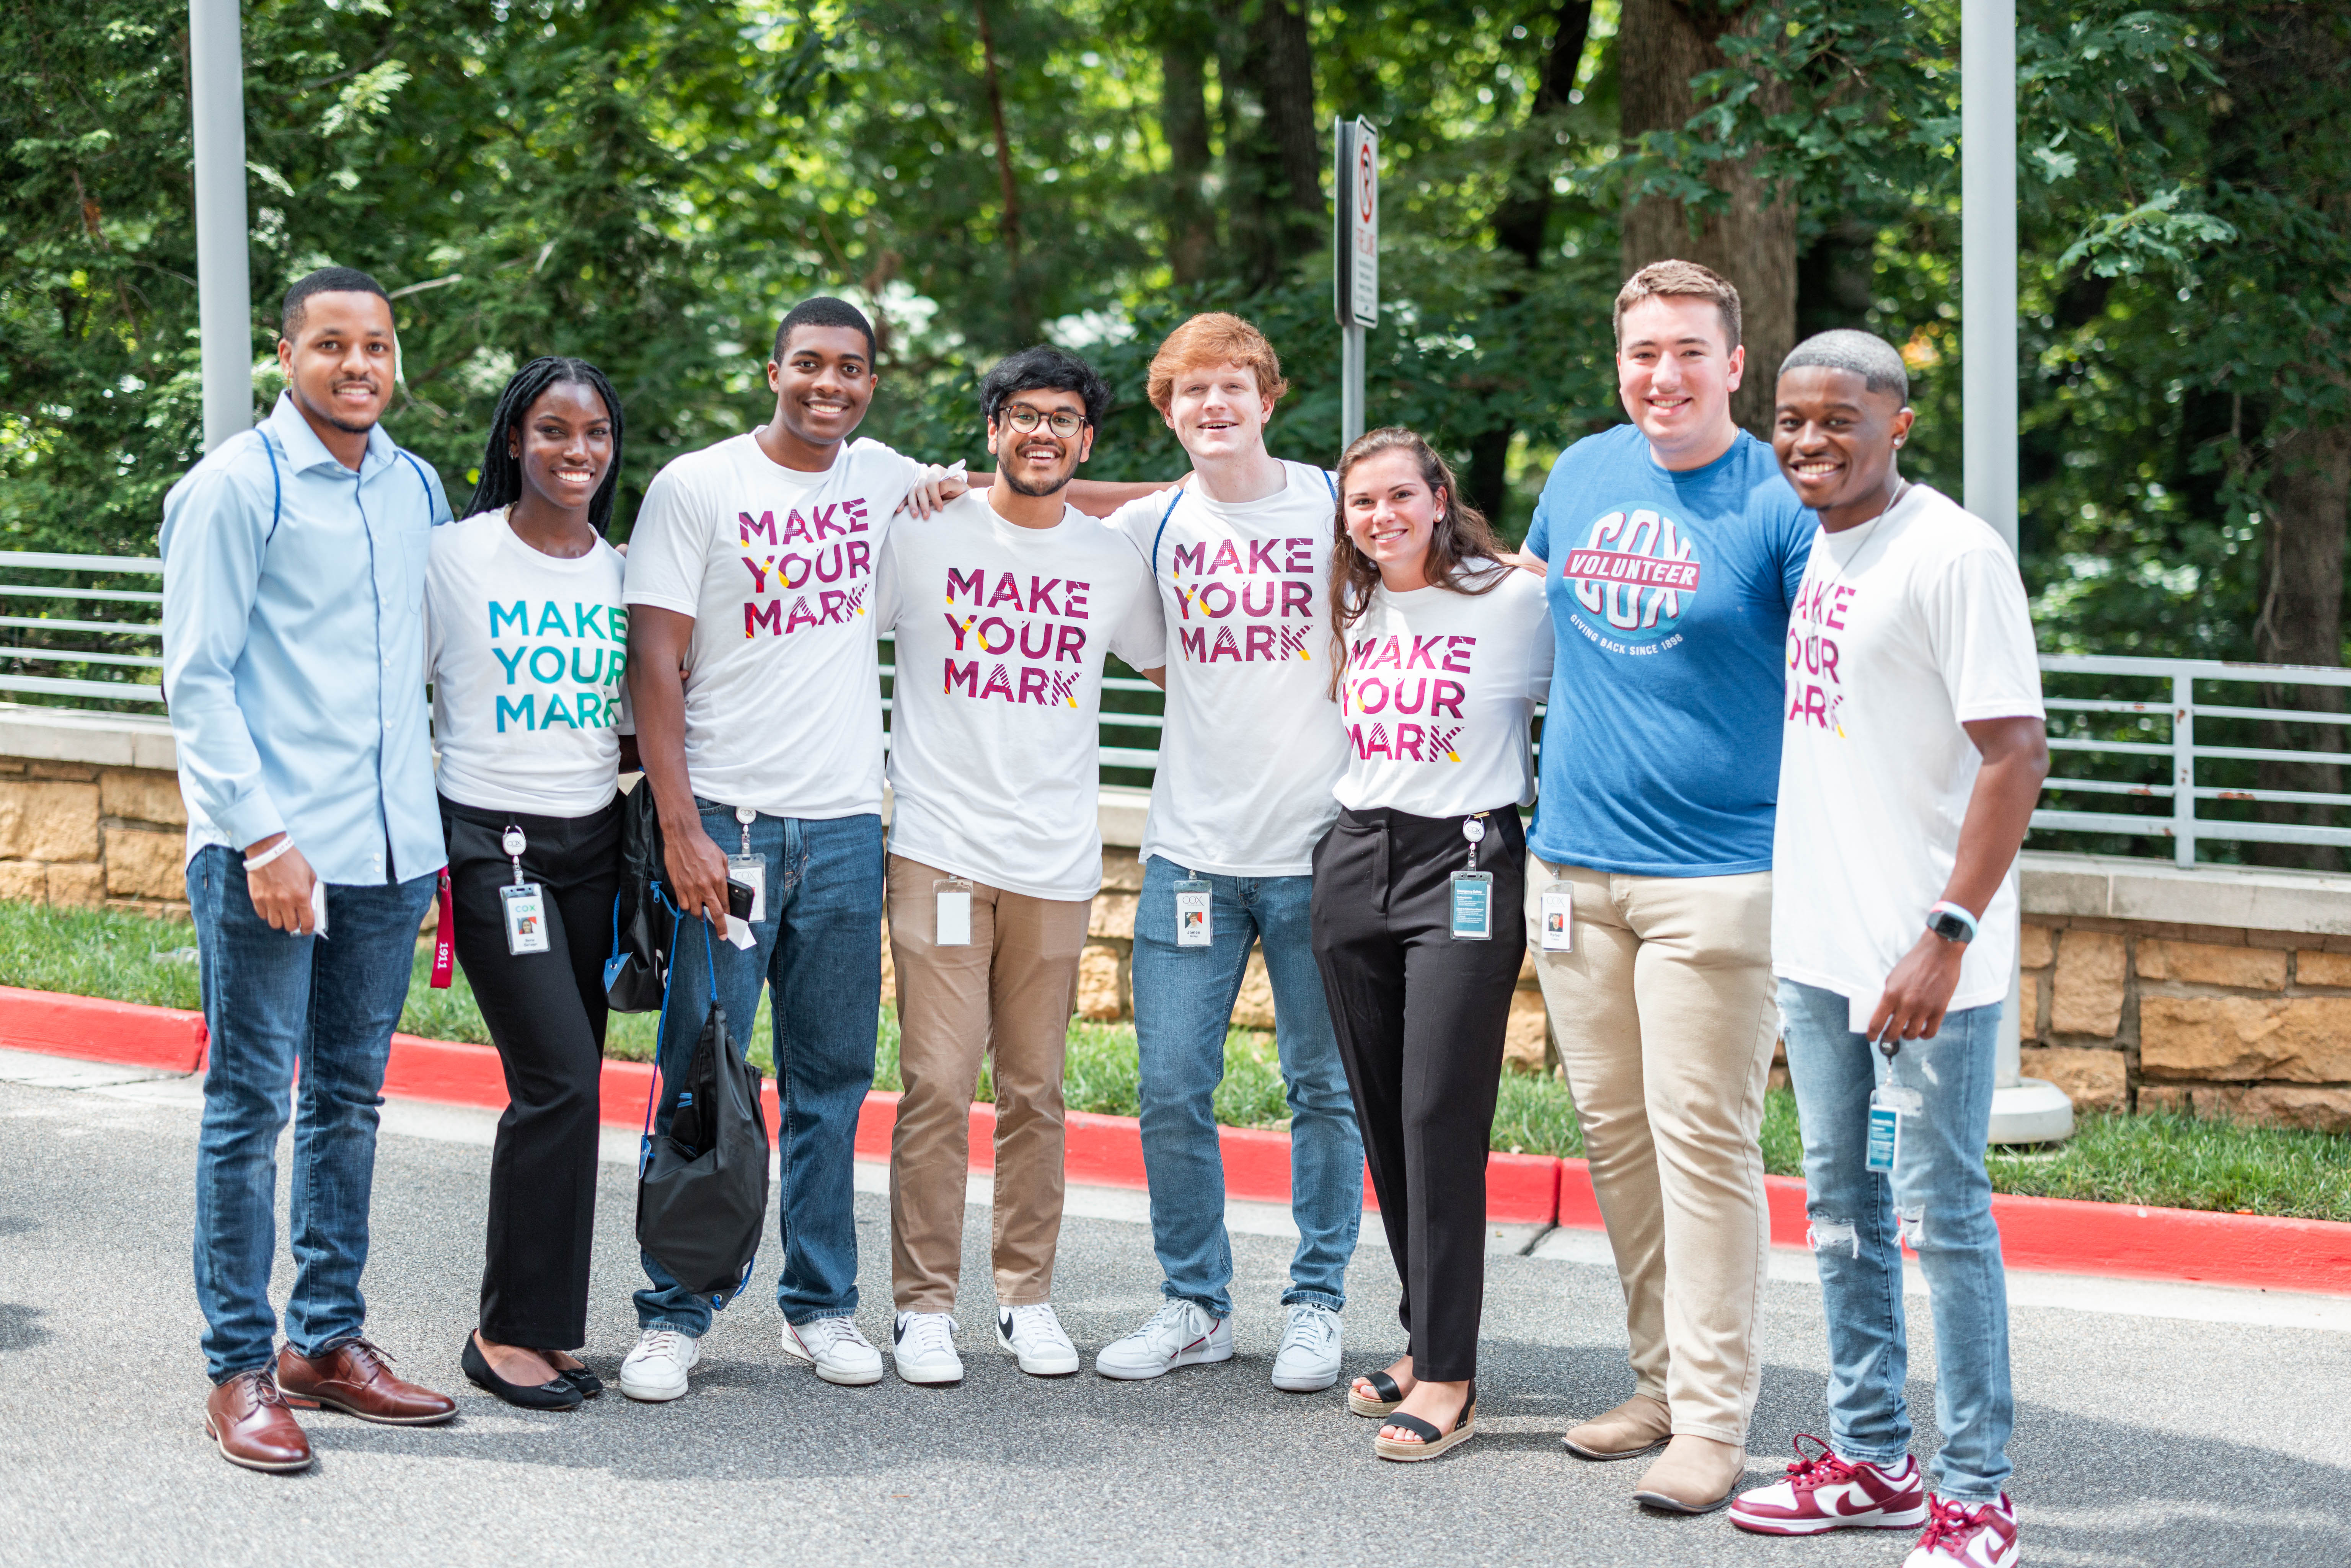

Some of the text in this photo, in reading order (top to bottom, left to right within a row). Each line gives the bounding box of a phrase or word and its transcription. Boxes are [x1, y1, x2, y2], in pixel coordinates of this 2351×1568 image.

[739, 498, 869, 547] MAKE
[741, 540, 871, 593] YOUR
[1174, 538, 1313, 579] MAKE
[1570, 554, 1697, 586] VOLUNTEER
[1575, 509, 1691, 631] COX
[744, 582, 869, 639] MARK
[946, 567, 1090, 619] MAKE
[1174, 581, 1313, 619] YOUR
[1793, 578, 1856, 631] AKE
[488, 600, 628, 646] MAKE
[944, 613, 1086, 663] YOUR
[1570, 614, 1683, 655] GIVING BACK SINCE 1898
[1179, 625, 1314, 663] MARK
[1346, 635, 1476, 674] MAKE
[1787, 628, 1840, 684] OUR
[491, 646, 627, 689] YOUR
[944, 658, 1083, 708] MARK
[496, 692, 621, 733] MARK
[1343, 677, 1465, 719] YOUR
[1786, 681, 1846, 738] ARK
[1345, 722, 1465, 763] MARK
[1467, 826, 1481, 835] COX
[735, 870, 756, 880] COX
[1182, 896, 1204, 906] COX
[1546, 896, 1565, 907] COX
[437, 942, 449, 969] 1911
